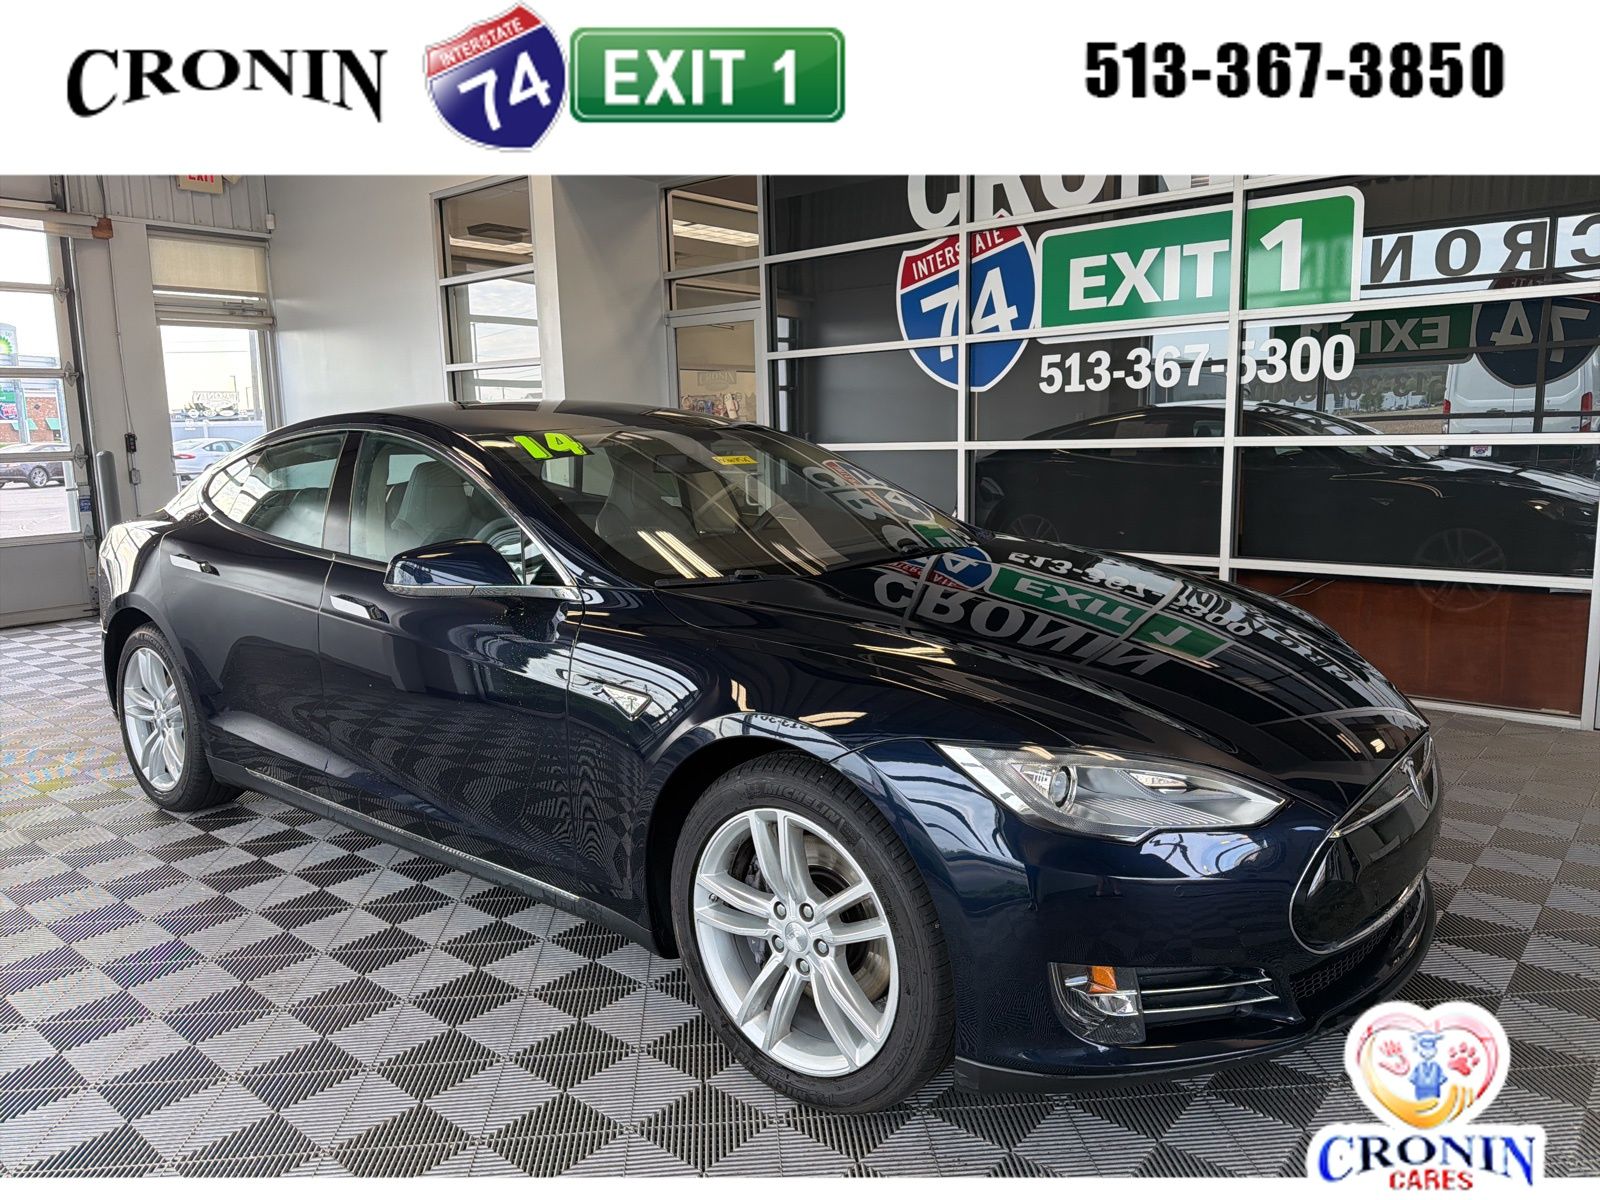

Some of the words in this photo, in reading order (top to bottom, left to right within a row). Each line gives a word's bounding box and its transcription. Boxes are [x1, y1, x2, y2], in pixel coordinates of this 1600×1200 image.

[912, 229, 1004, 280] INTERSATE
[1069, 239, 1230, 311] EXIT
[1260, 218, 1303, 292] 1
[920, 267, 1018, 362] 74
[513, 432, 588, 459] 14
